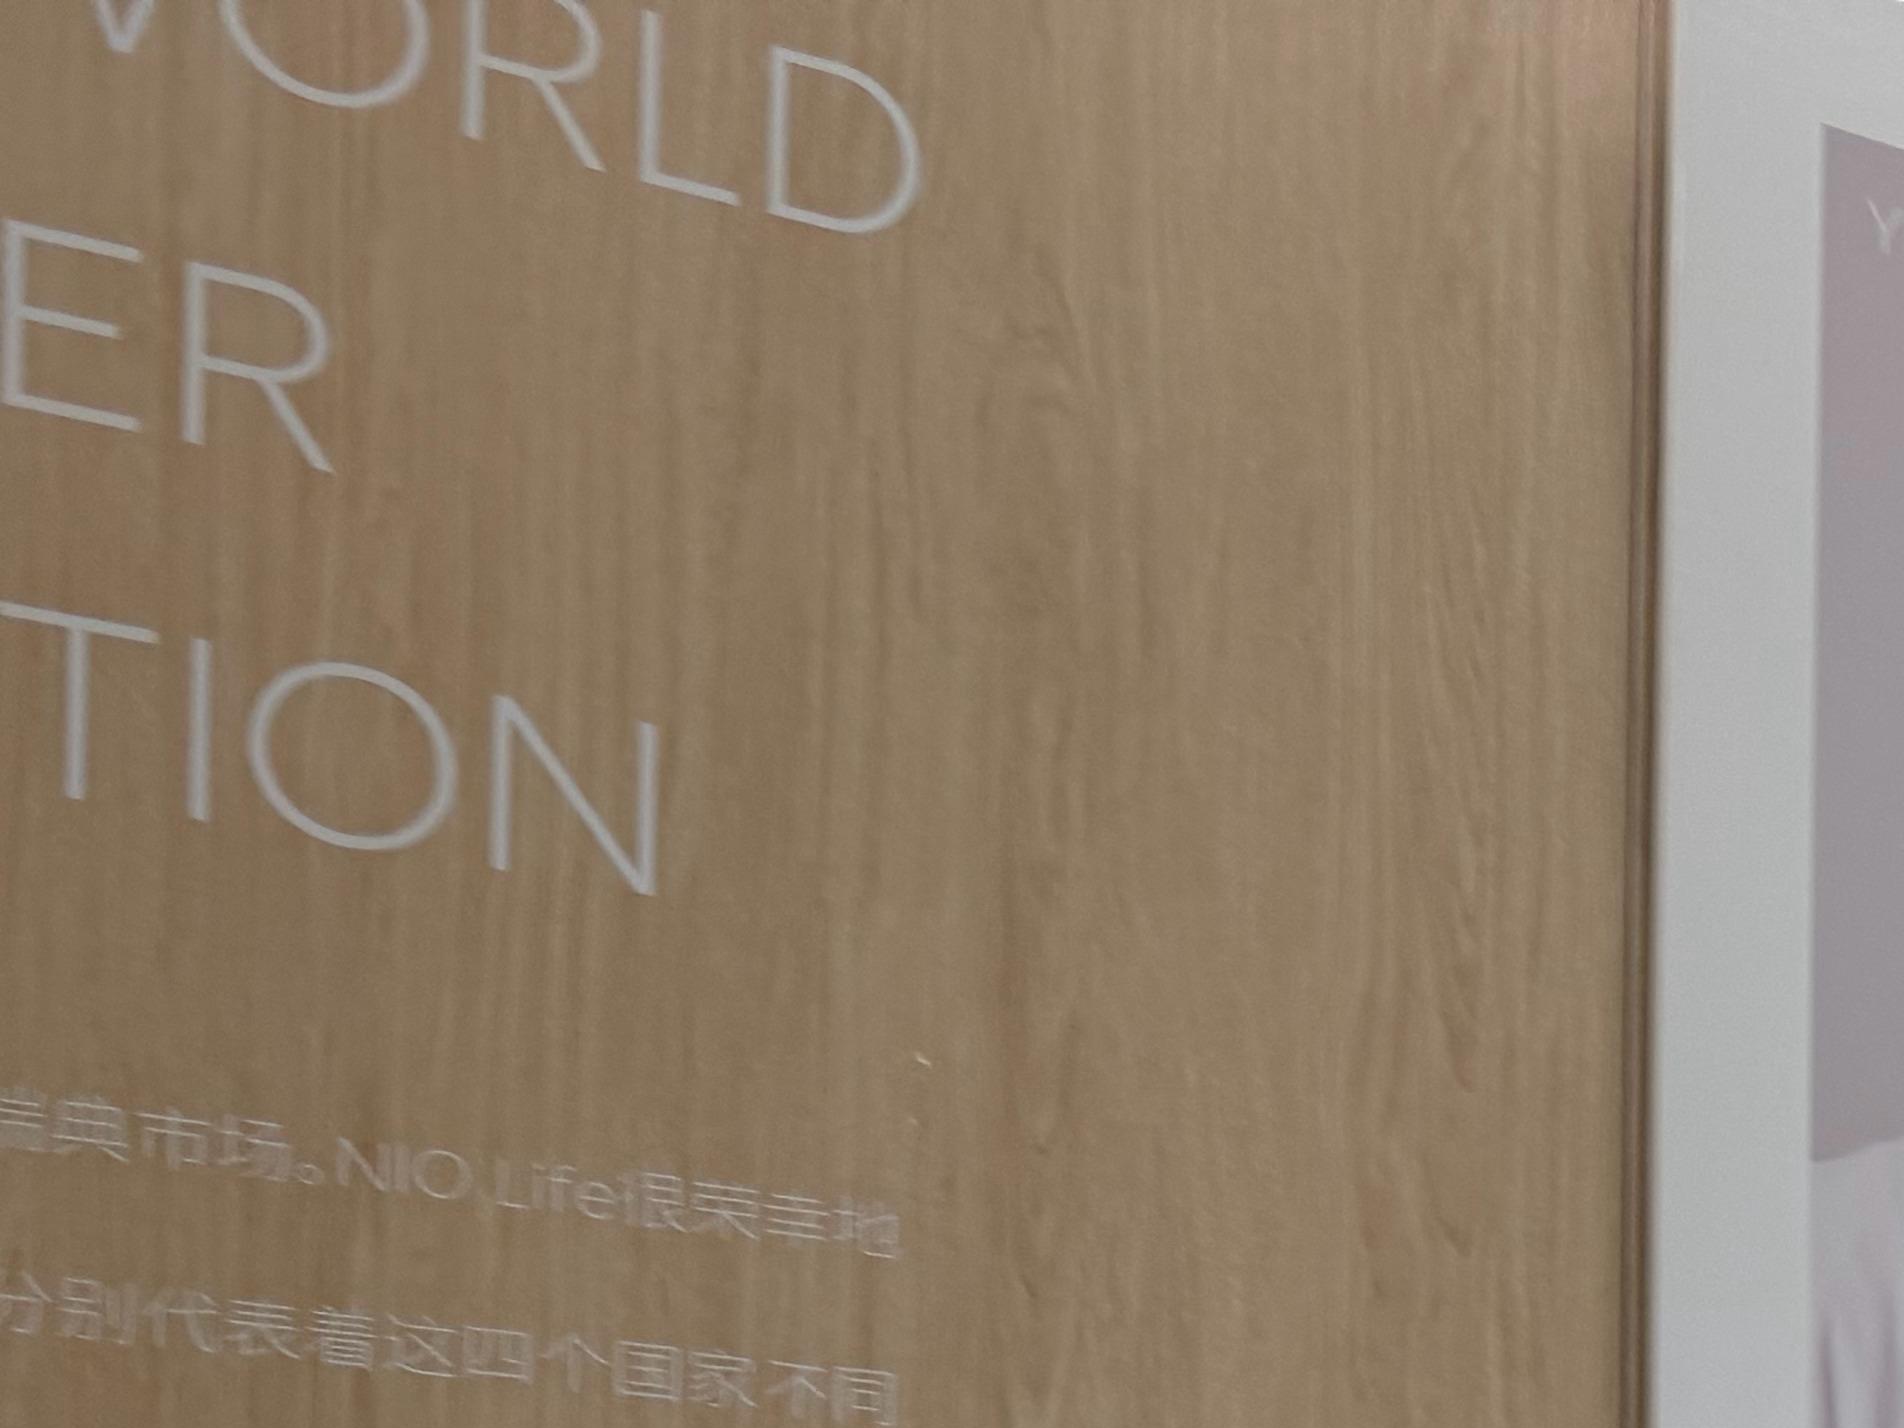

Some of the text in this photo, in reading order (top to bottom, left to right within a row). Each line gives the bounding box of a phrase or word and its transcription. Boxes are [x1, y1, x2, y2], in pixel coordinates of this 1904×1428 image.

[92, 0, 924, 234] ORLD
[4, 220, 336, 475] ER
[0, 602, 660, 896] TION
